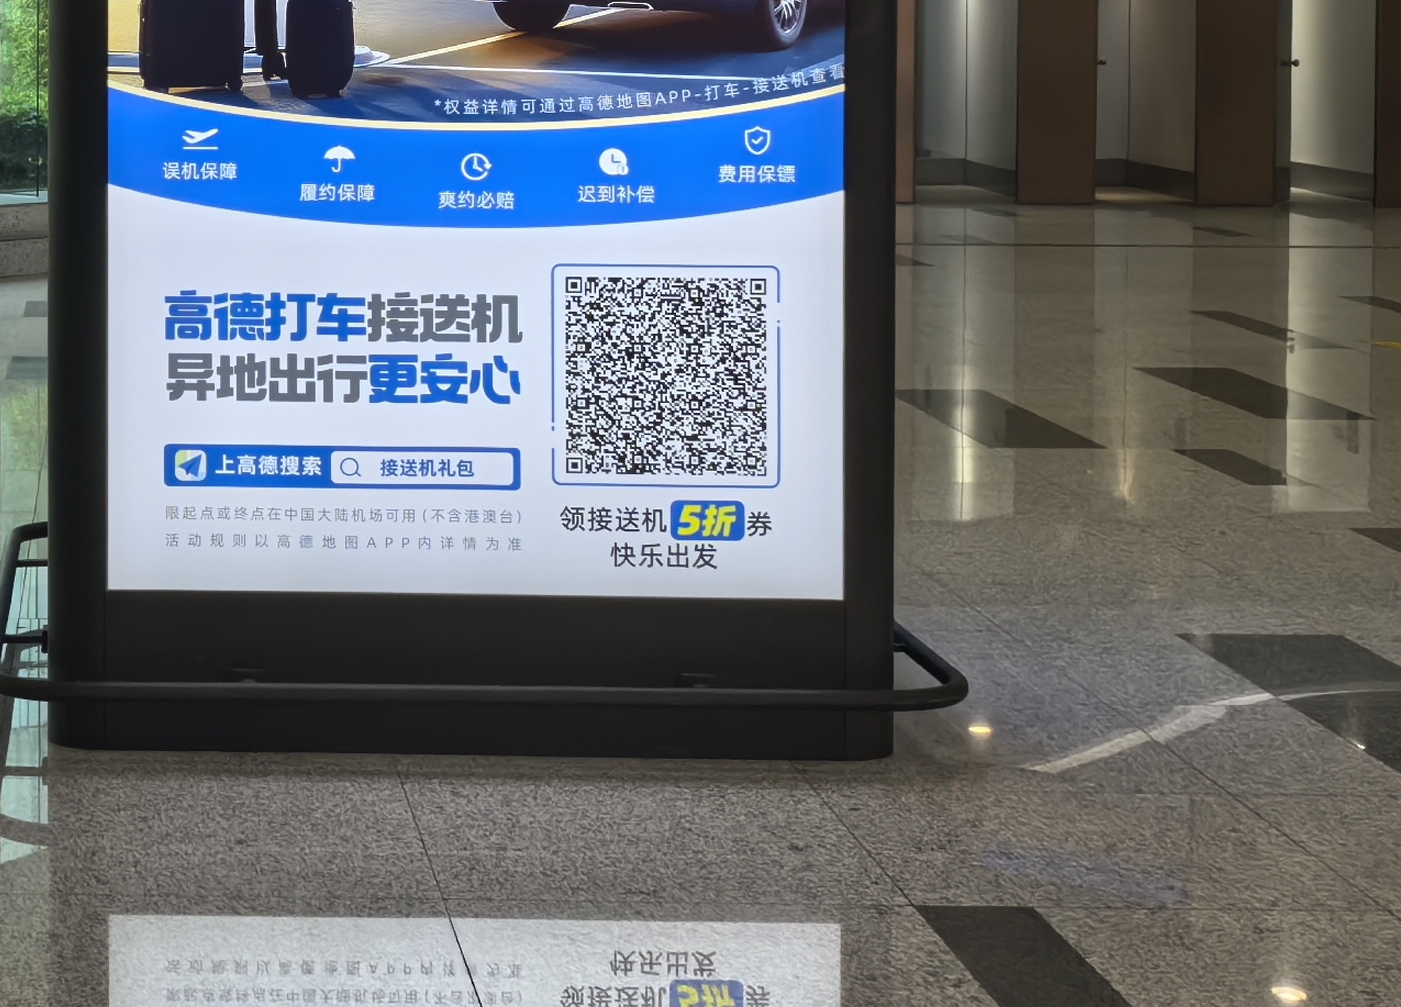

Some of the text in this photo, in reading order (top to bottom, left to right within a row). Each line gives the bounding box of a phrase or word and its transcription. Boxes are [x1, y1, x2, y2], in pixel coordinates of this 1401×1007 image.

[163, 161, 238, 181] 误机保障
[718, 164, 796, 184] 费用保镖
[299, 183, 376, 203] 履约保障
[438, 191, 515, 210] 爽约必赔
[578, 184, 656, 205] 迟到补偿
[164, 289, 523, 343] 高德打车接送机
[166, 352, 521, 404] 异地出行更安心
[215, 454, 322, 476] 上高德搜索
[380, 458, 475, 478] 接送机礼包
[560, 504, 773, 538] 领接送机5折券
[610, 542, 718, 570] 快乐出发
